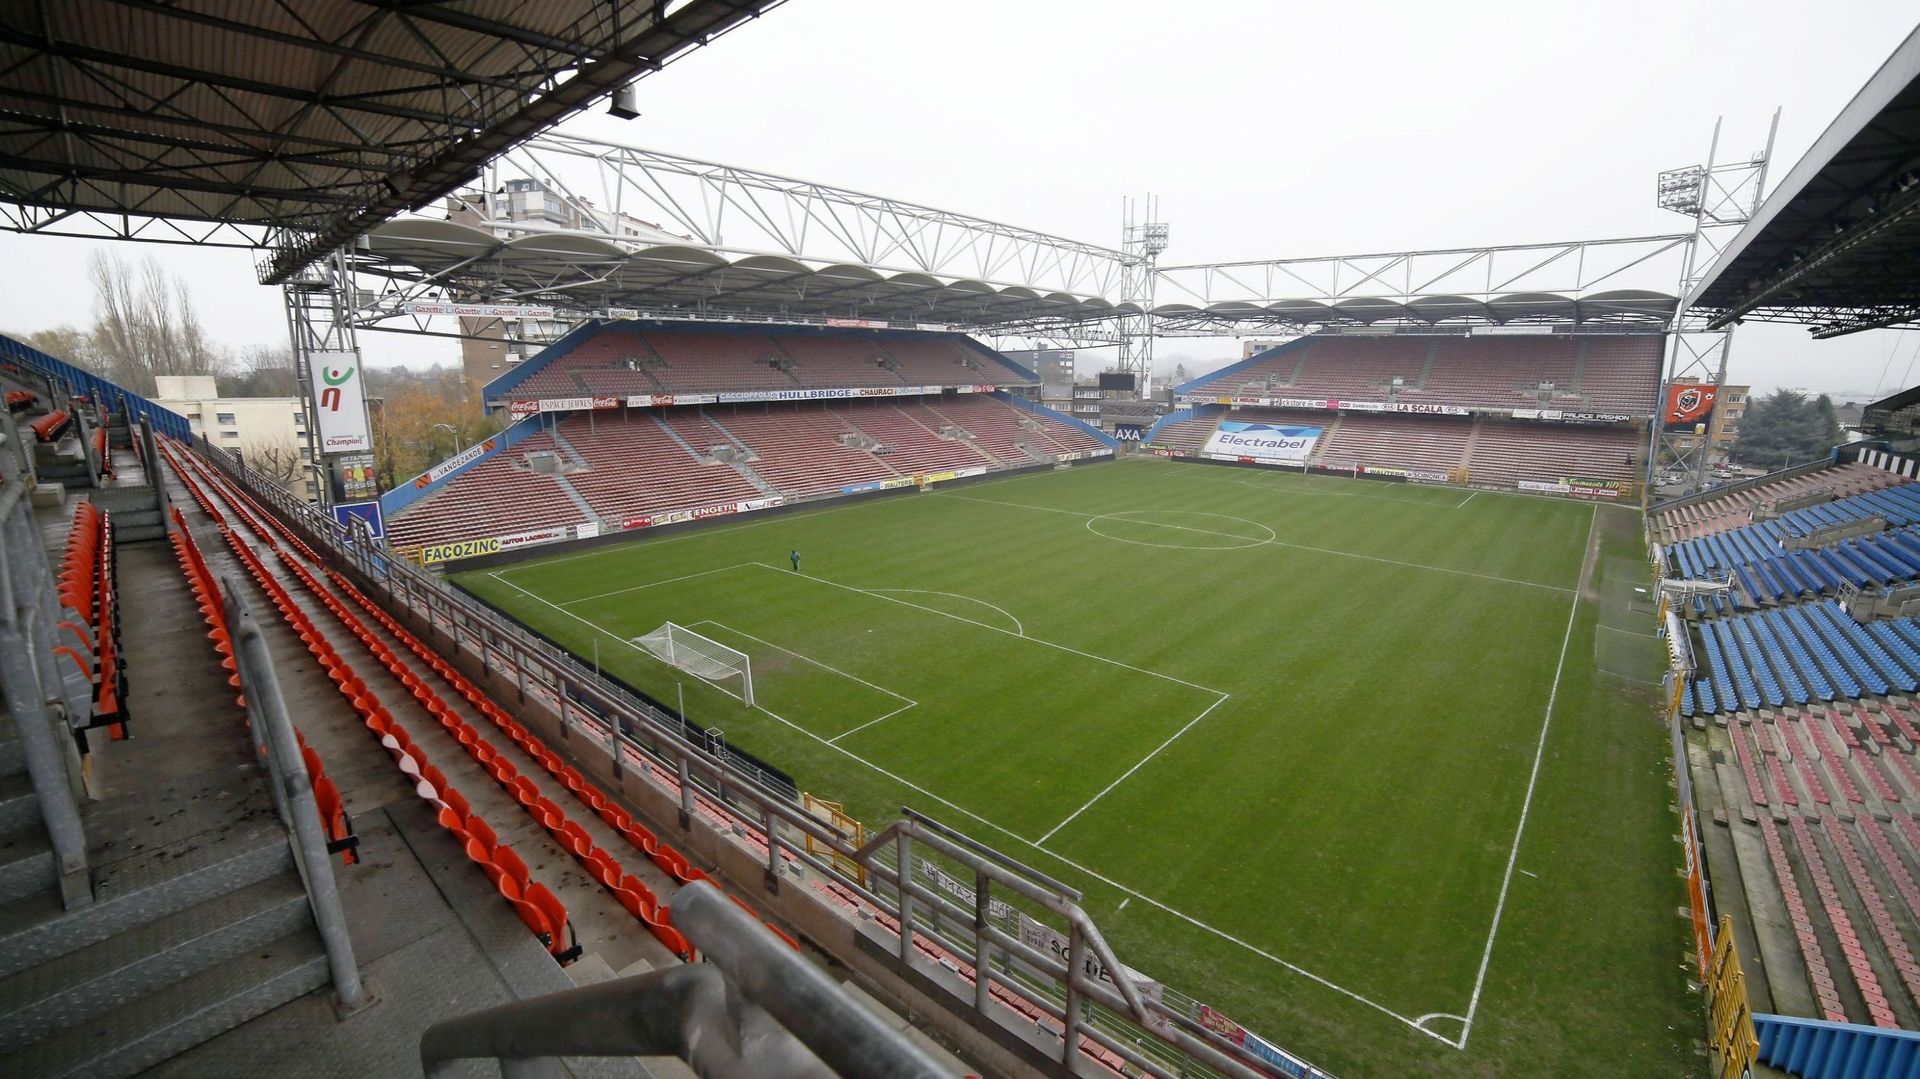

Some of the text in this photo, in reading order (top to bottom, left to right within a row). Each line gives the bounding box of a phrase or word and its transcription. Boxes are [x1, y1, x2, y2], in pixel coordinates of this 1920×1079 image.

[416, 305, 444, 313] Gazette
[455, 307, 481, 315] Gazette
[493, 308, 518, 316] Gazette
[528, 309, 551, 317] Gazette
[779, 389, 851, 399] HULLBRIDGE
[860, 388, 893, 397] CHAURACI
[541, 399, 593, 410] ESPACE JEUNES
[1411, 405, 1443, 413] SCALA
[1596, 413, 1630, 421] FASHION
[1116, 428, 1141, 441] AXA
[326, 437, 363, 446] Champion
[1219, 434, 1306, 449] Electrabel
[439, 447, 482, 475] VANDEZANDE
[695, 503, 737, 516] ENGETIL
[502, 536, 523, 545] AUTOS
[424, 539, 499, 561] FACOZINC
